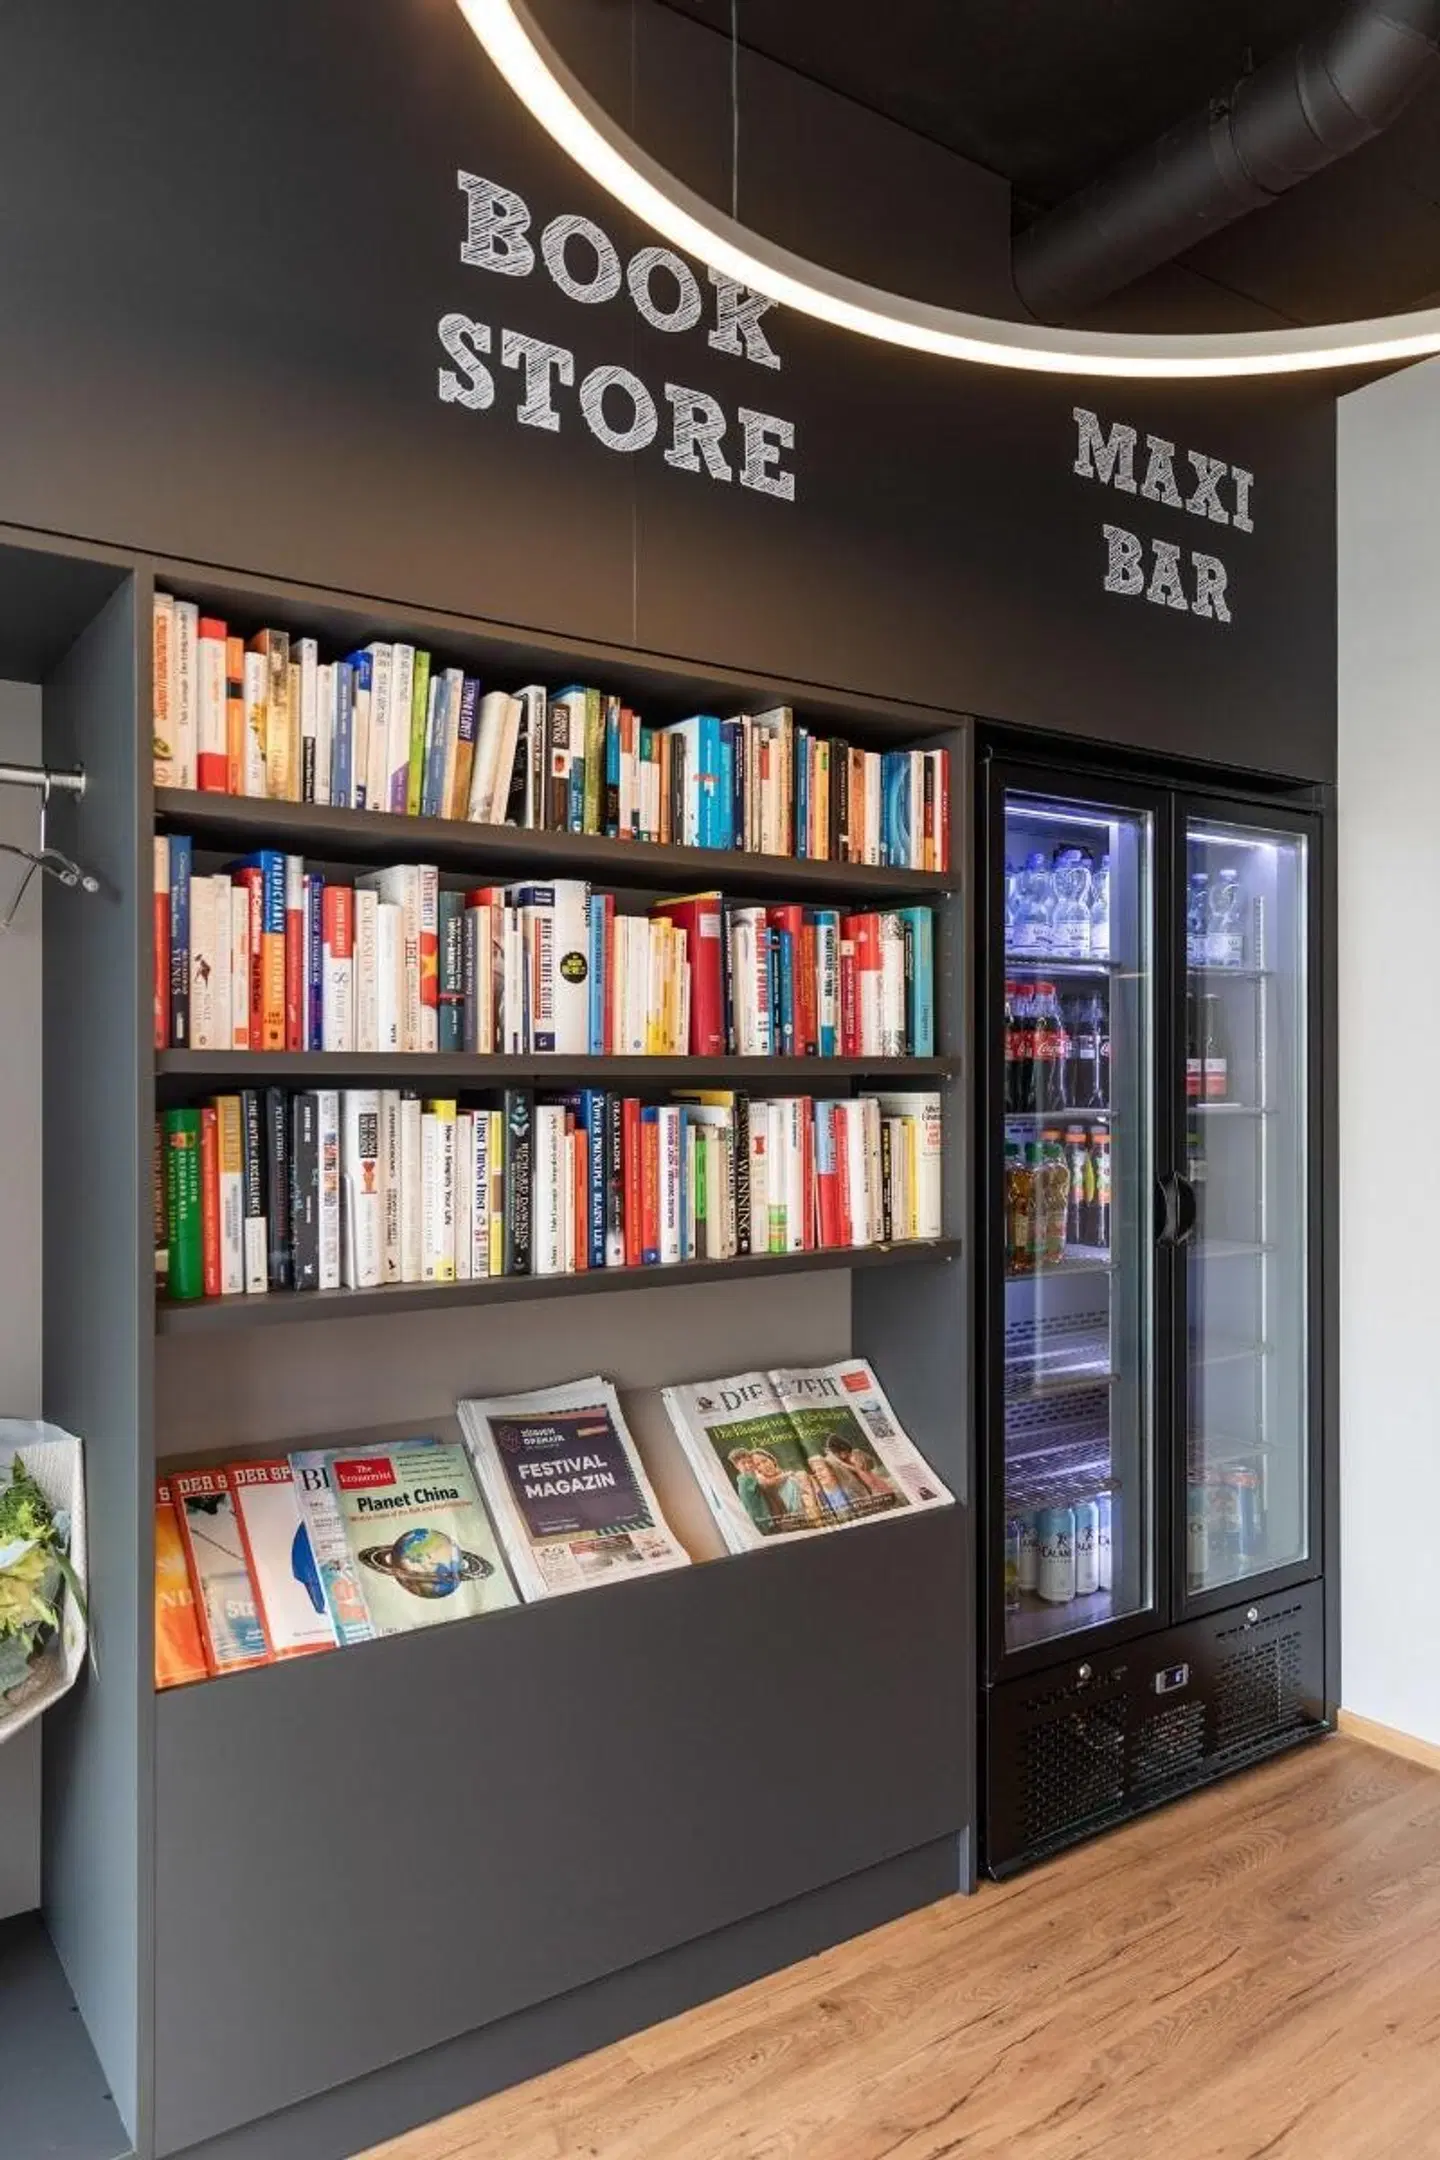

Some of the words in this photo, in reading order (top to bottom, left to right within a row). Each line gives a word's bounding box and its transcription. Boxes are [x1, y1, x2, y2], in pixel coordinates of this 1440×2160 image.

[457, 169, 781, 371] BOOK
[438, 313, 794, 501] STORE
[1073, 407, 1254, 533] MAXI
[1102, 523, 1231, 622] BAR
[272, 856, 284, 932] PREDICTABLY
[171, 947, 182, 994] YUNUS
[444, 1123, 453, 1140] How
[249, 1156, 261, 1215] EXCELLENCE
[520, 1141, 530, 1193] RICHARD
[592, 1136, 605, 1186] PRINCIPLE
[520, 1194, 530, 1247] DAWKINS
[737, 1158, 750, 1237] WINNING
[177, 1476, 213, 1494] DER
[235, 1468, 269, 1485] DER
[340, 1471, 392, 1485] Economist
[356, 1464, 373, 1474] The
[518, 1454, 607, 1480] FESTIVAL
[524, 1472, 616, 1500] MAGAZIN
[357, 1494, 411, 1512] Planet
[413, 1486, 460, 1505] China
